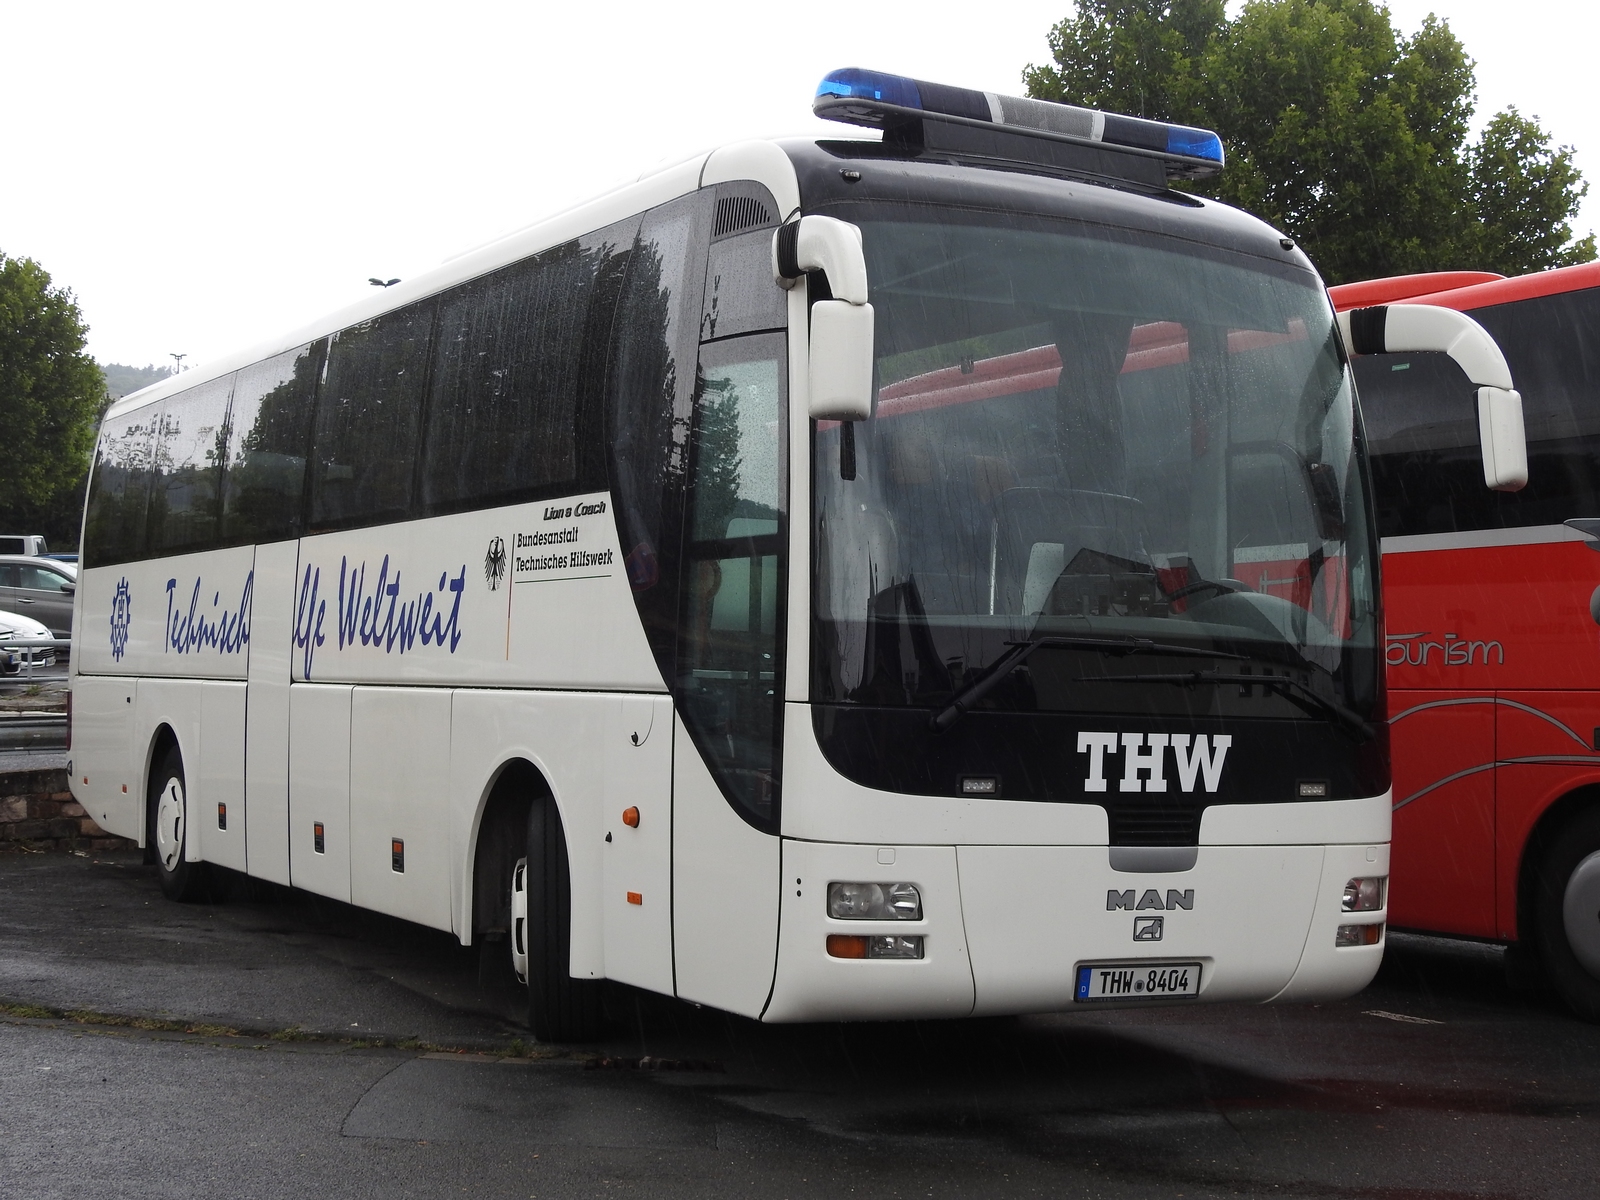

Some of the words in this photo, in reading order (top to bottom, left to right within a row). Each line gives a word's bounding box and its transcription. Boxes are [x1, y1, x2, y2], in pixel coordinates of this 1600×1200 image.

[574, 501, 606, 517] Coach
[517, 526, 578, 548] Bundesanstalt
[516, 554, 568, 572] Technisches
[570, 548, 613, 568] Hilfswerk
[293, 563, 326, 680] lfe
[338, 554, 466, 655] Weltweit
[1077, 731, 1232, 793] THW
[1106, 889, 1195, 911] MAN
[1100, 971, 1134, 994] THW
[1146, 969, 1188, 992] 8404
